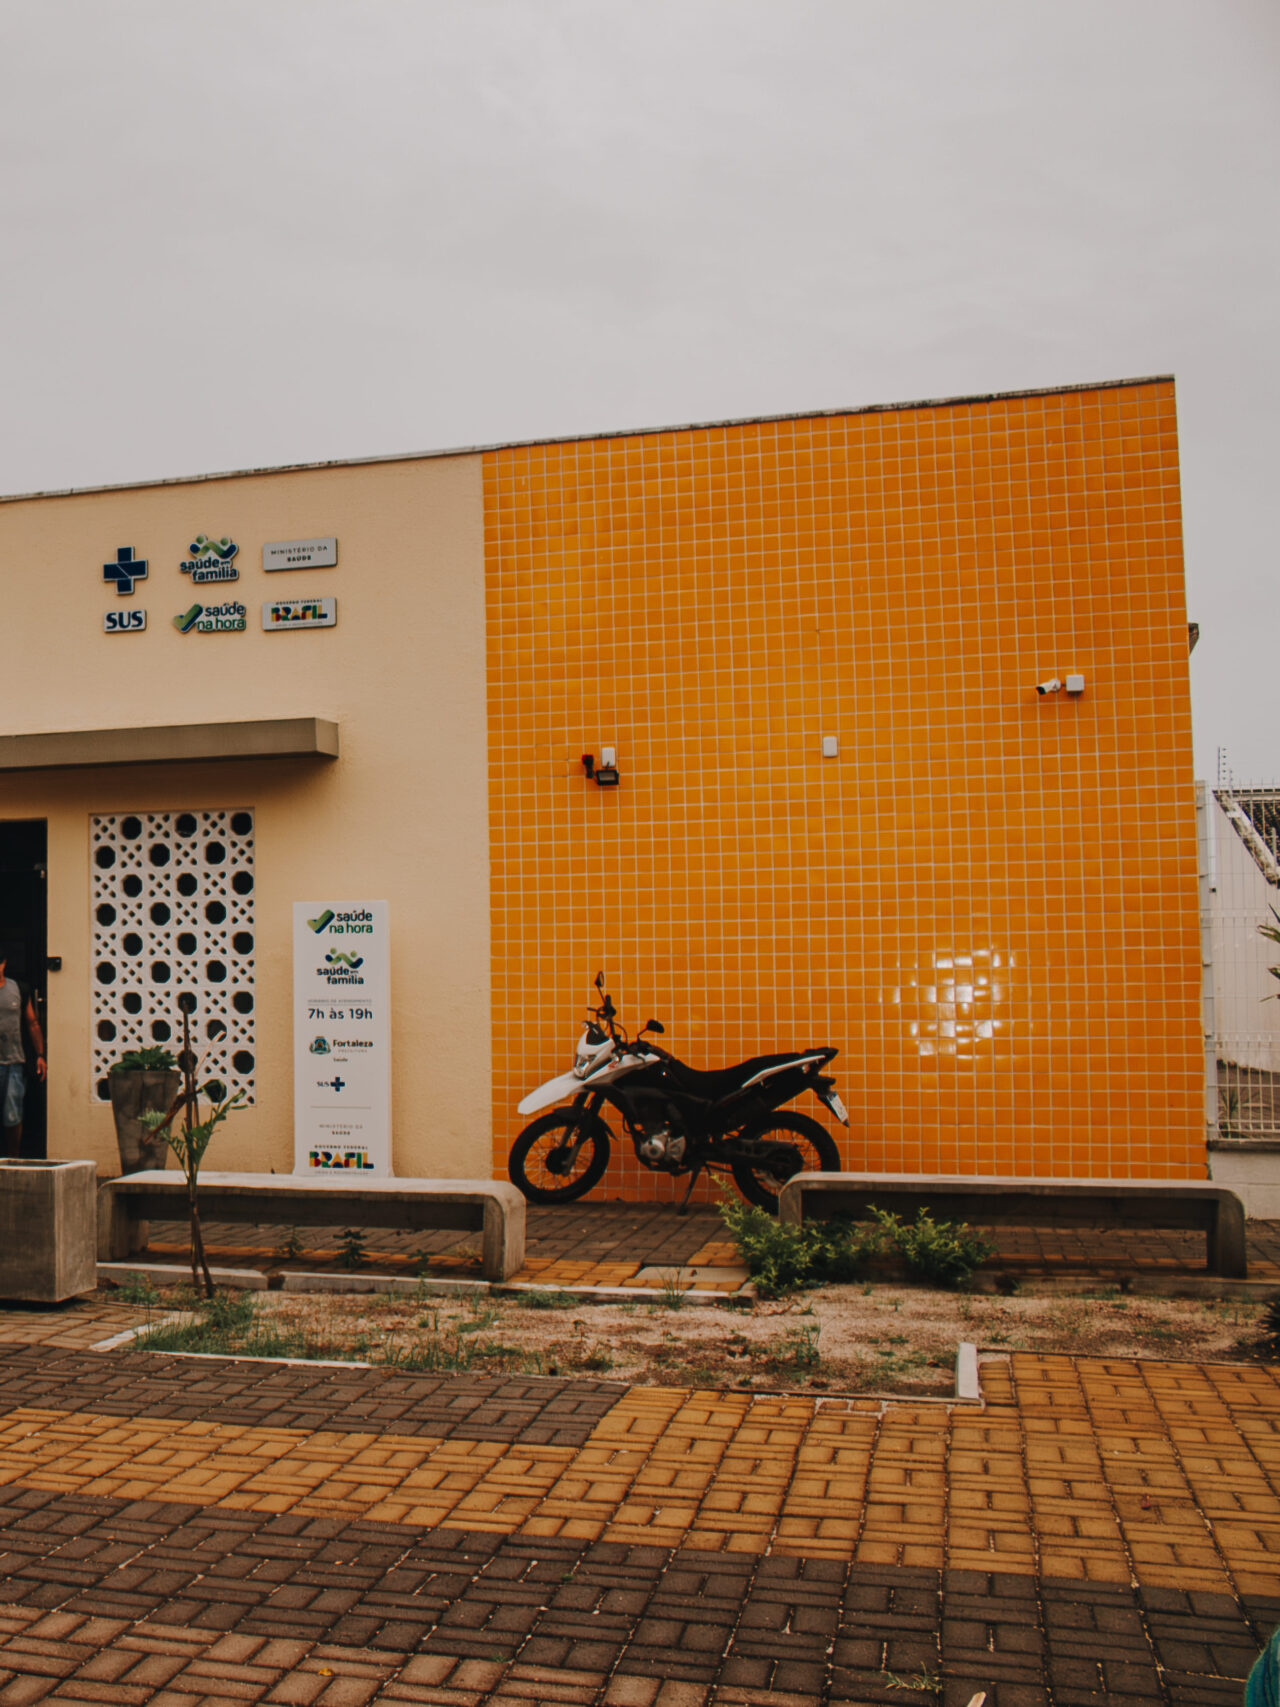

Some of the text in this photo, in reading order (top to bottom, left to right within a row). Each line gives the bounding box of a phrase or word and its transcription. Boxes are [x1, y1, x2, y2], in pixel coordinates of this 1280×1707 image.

[180, 556, 220, 571] saúde
[192, 566, 237, 581] família
[205, 601, 245, 616] saúde
[271, 605, 328, 622] BRASIL
[106, 610, 144, 630] SUS
[197, 617, 245, 630] na hora
[336, 908, 373, 922] saúde
[329, 922, 373, 934] na hora
[316, 966, 350, 976] saúde
[327, 975, 364, 985] família
[308, 1007, 373, 1020] 7h às 19h
[333, 1039, 374, 1048] Fortaleza
[309, 1151, 374, 1169] BRASIL
